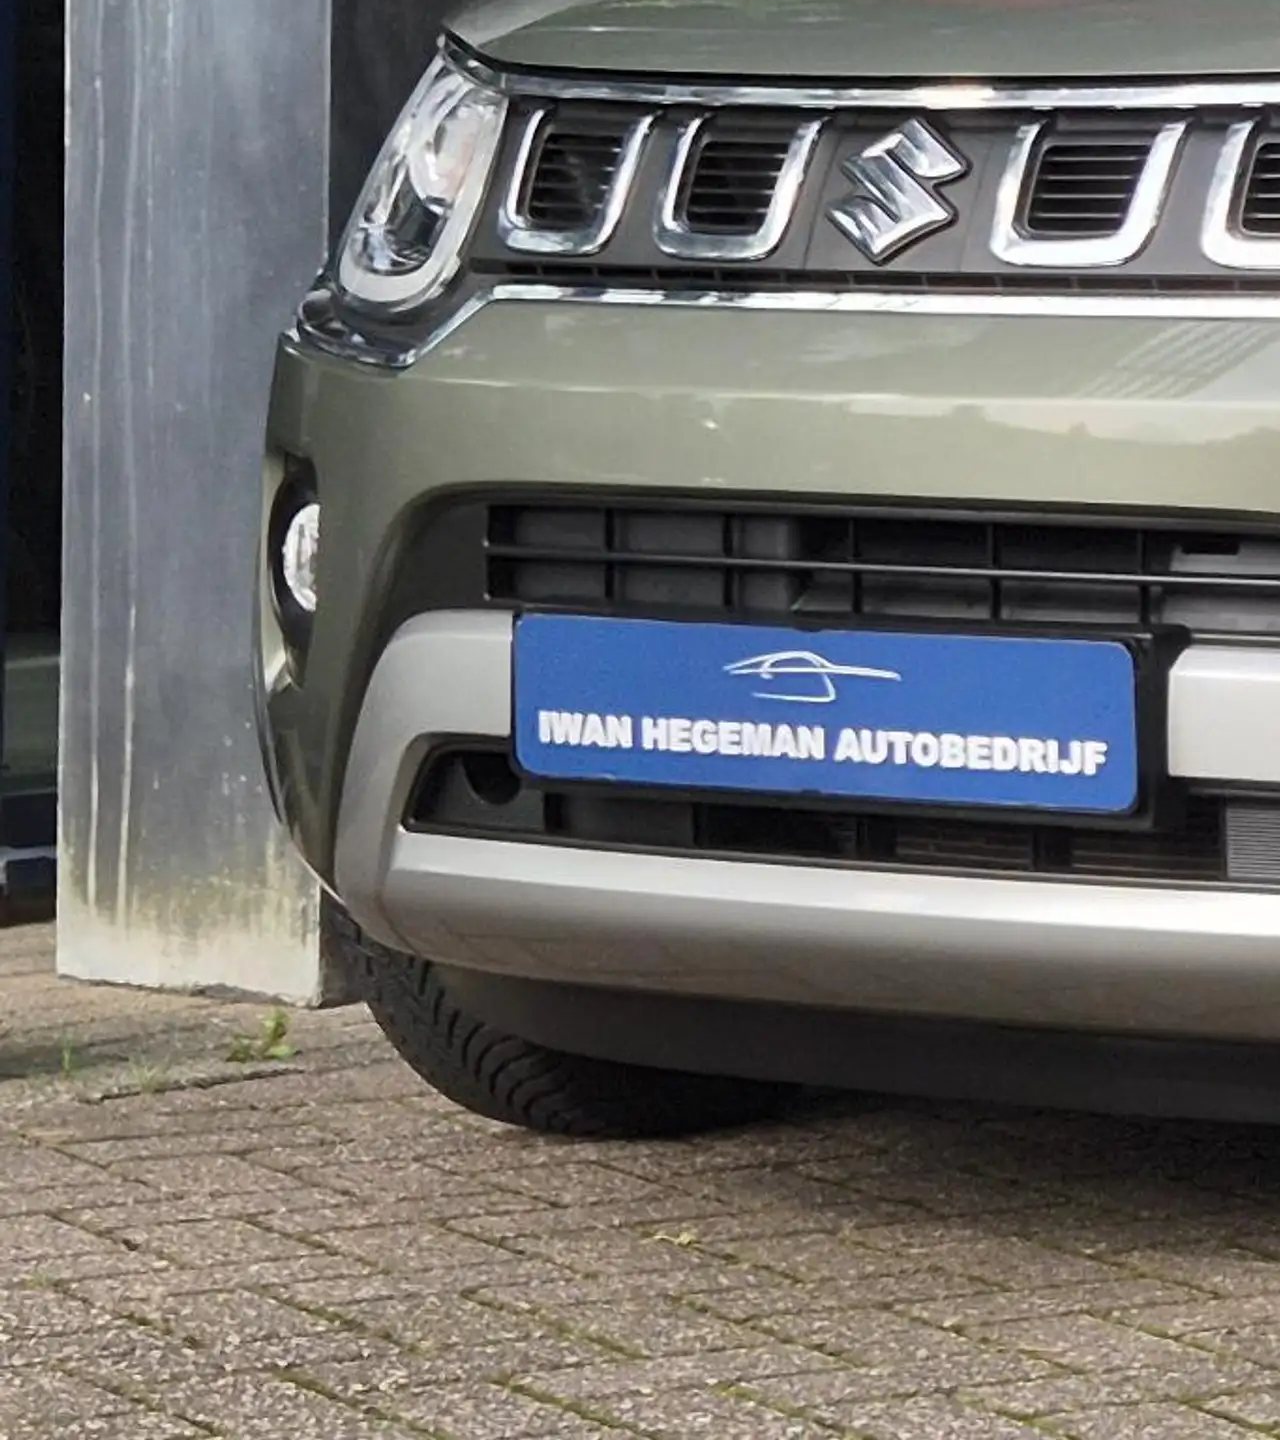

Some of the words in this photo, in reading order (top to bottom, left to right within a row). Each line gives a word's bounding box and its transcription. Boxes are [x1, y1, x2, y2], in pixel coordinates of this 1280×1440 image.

[538, 710, 634, 749] IWAN
[641, 716, 826, 761] HEGEMAN
[833, 727, 1108, 776] AUTOBEDRIJF
